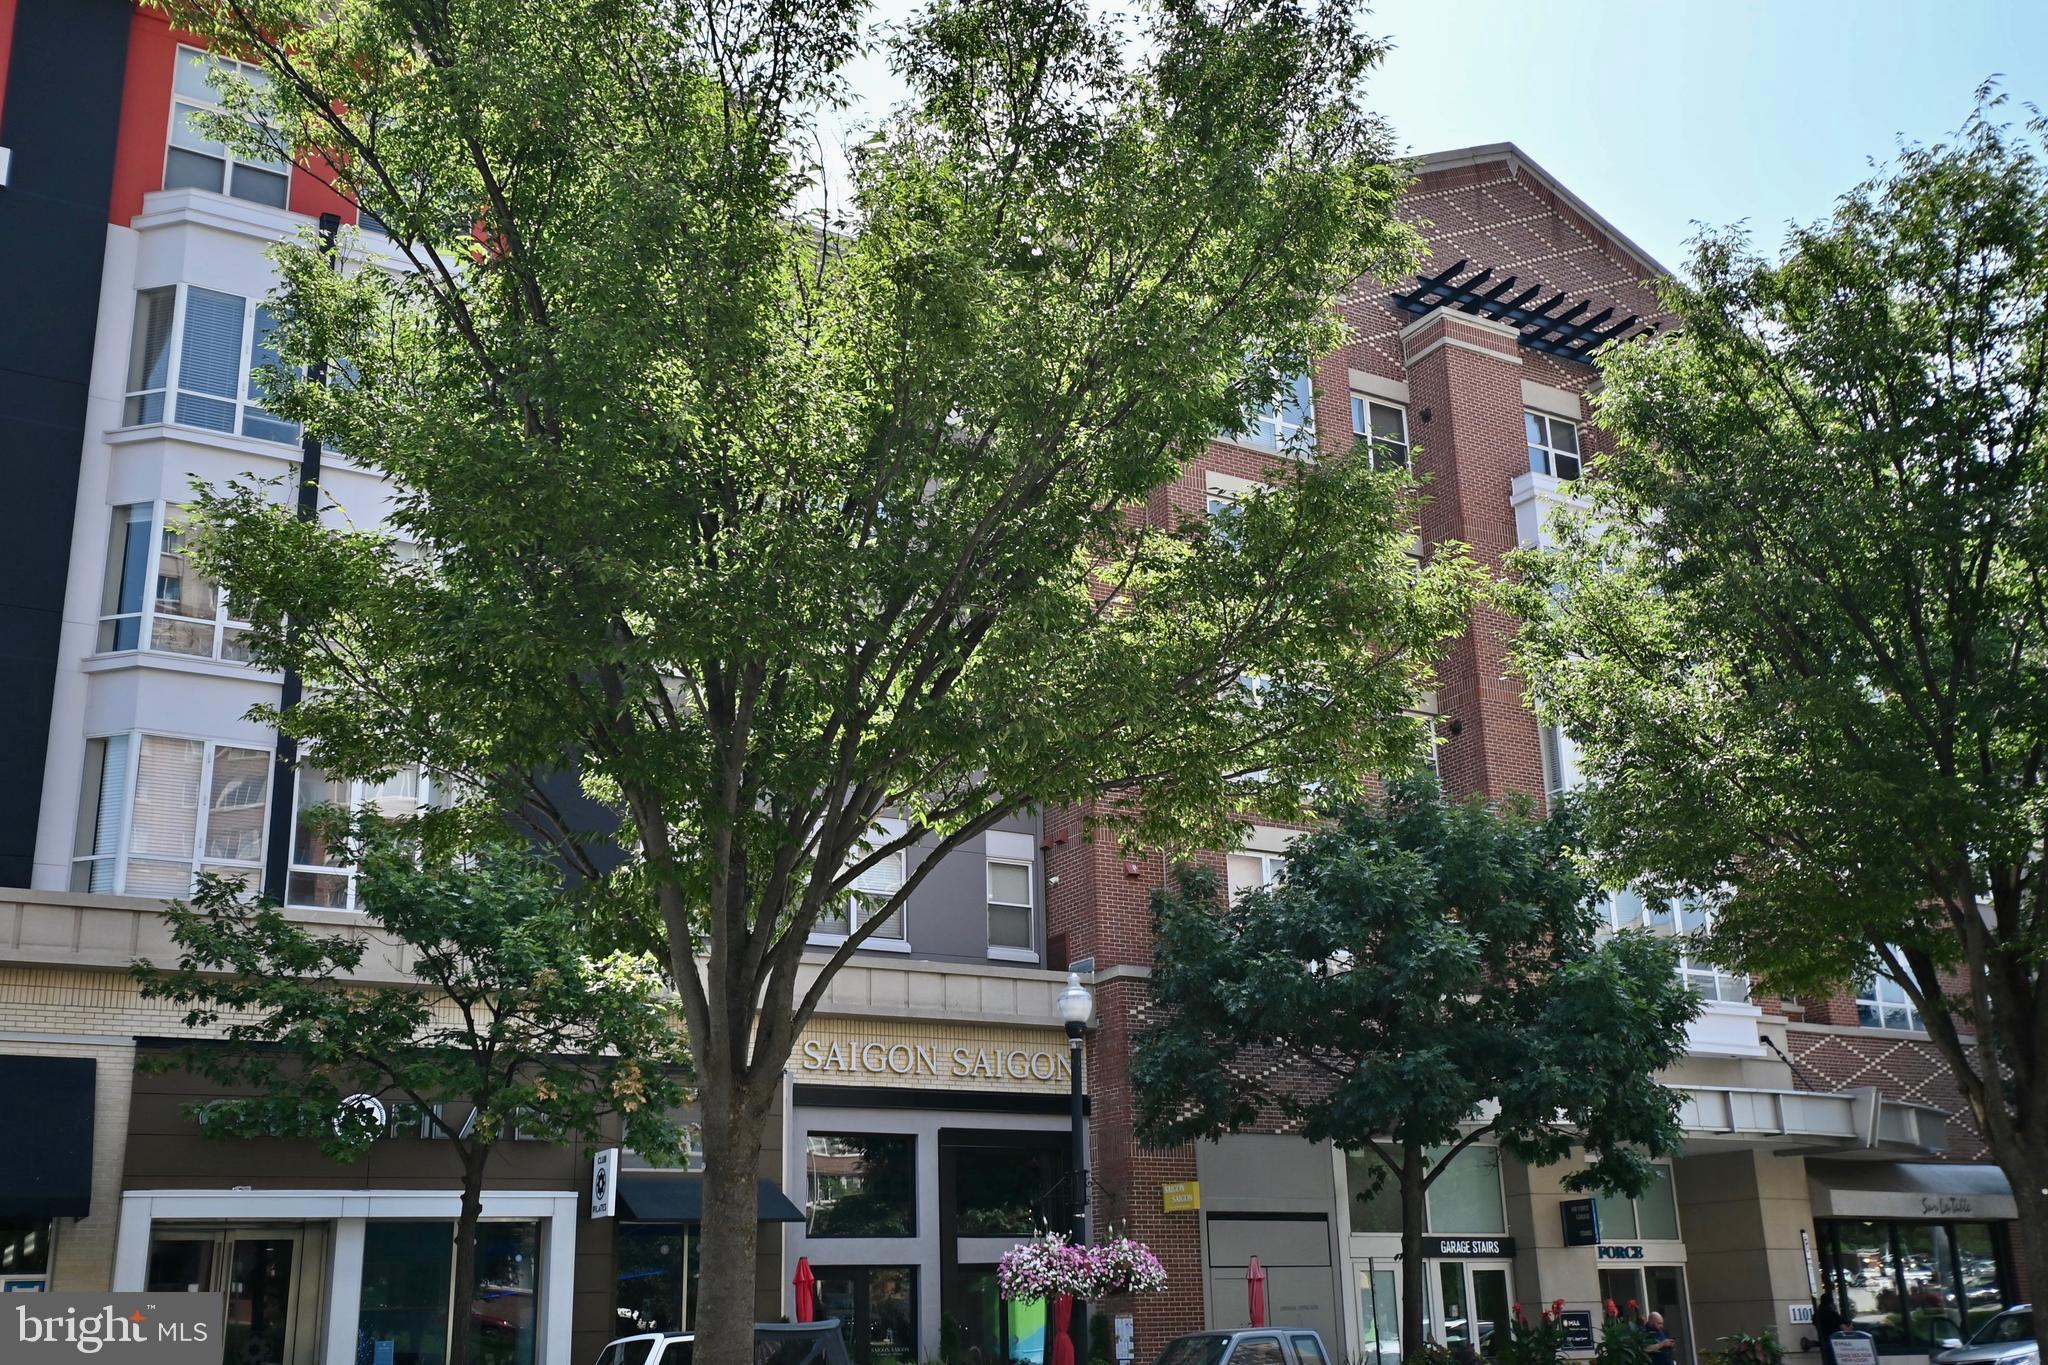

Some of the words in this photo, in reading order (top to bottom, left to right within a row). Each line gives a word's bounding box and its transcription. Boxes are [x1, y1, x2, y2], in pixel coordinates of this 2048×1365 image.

[802, 1040, 937, 1075] SAIGON
[951, 1047, 1071, 1081] SAIGON
[597, 1155, 607, 1165] CLUB
[1164, 1184, 1185, 1193] SAIGON
[1172, 1193, 1193, 1202] SAIGON
[592, 1203, 607, 1213] PILATES
[1921, 1196, 1938, 1215] Sur
[1440, 1240, 1471, 1254] GARAGE
[1472, 1240, 1500, 1254] STAIRS
[1792, 1307, 1813, 1321] 1101
